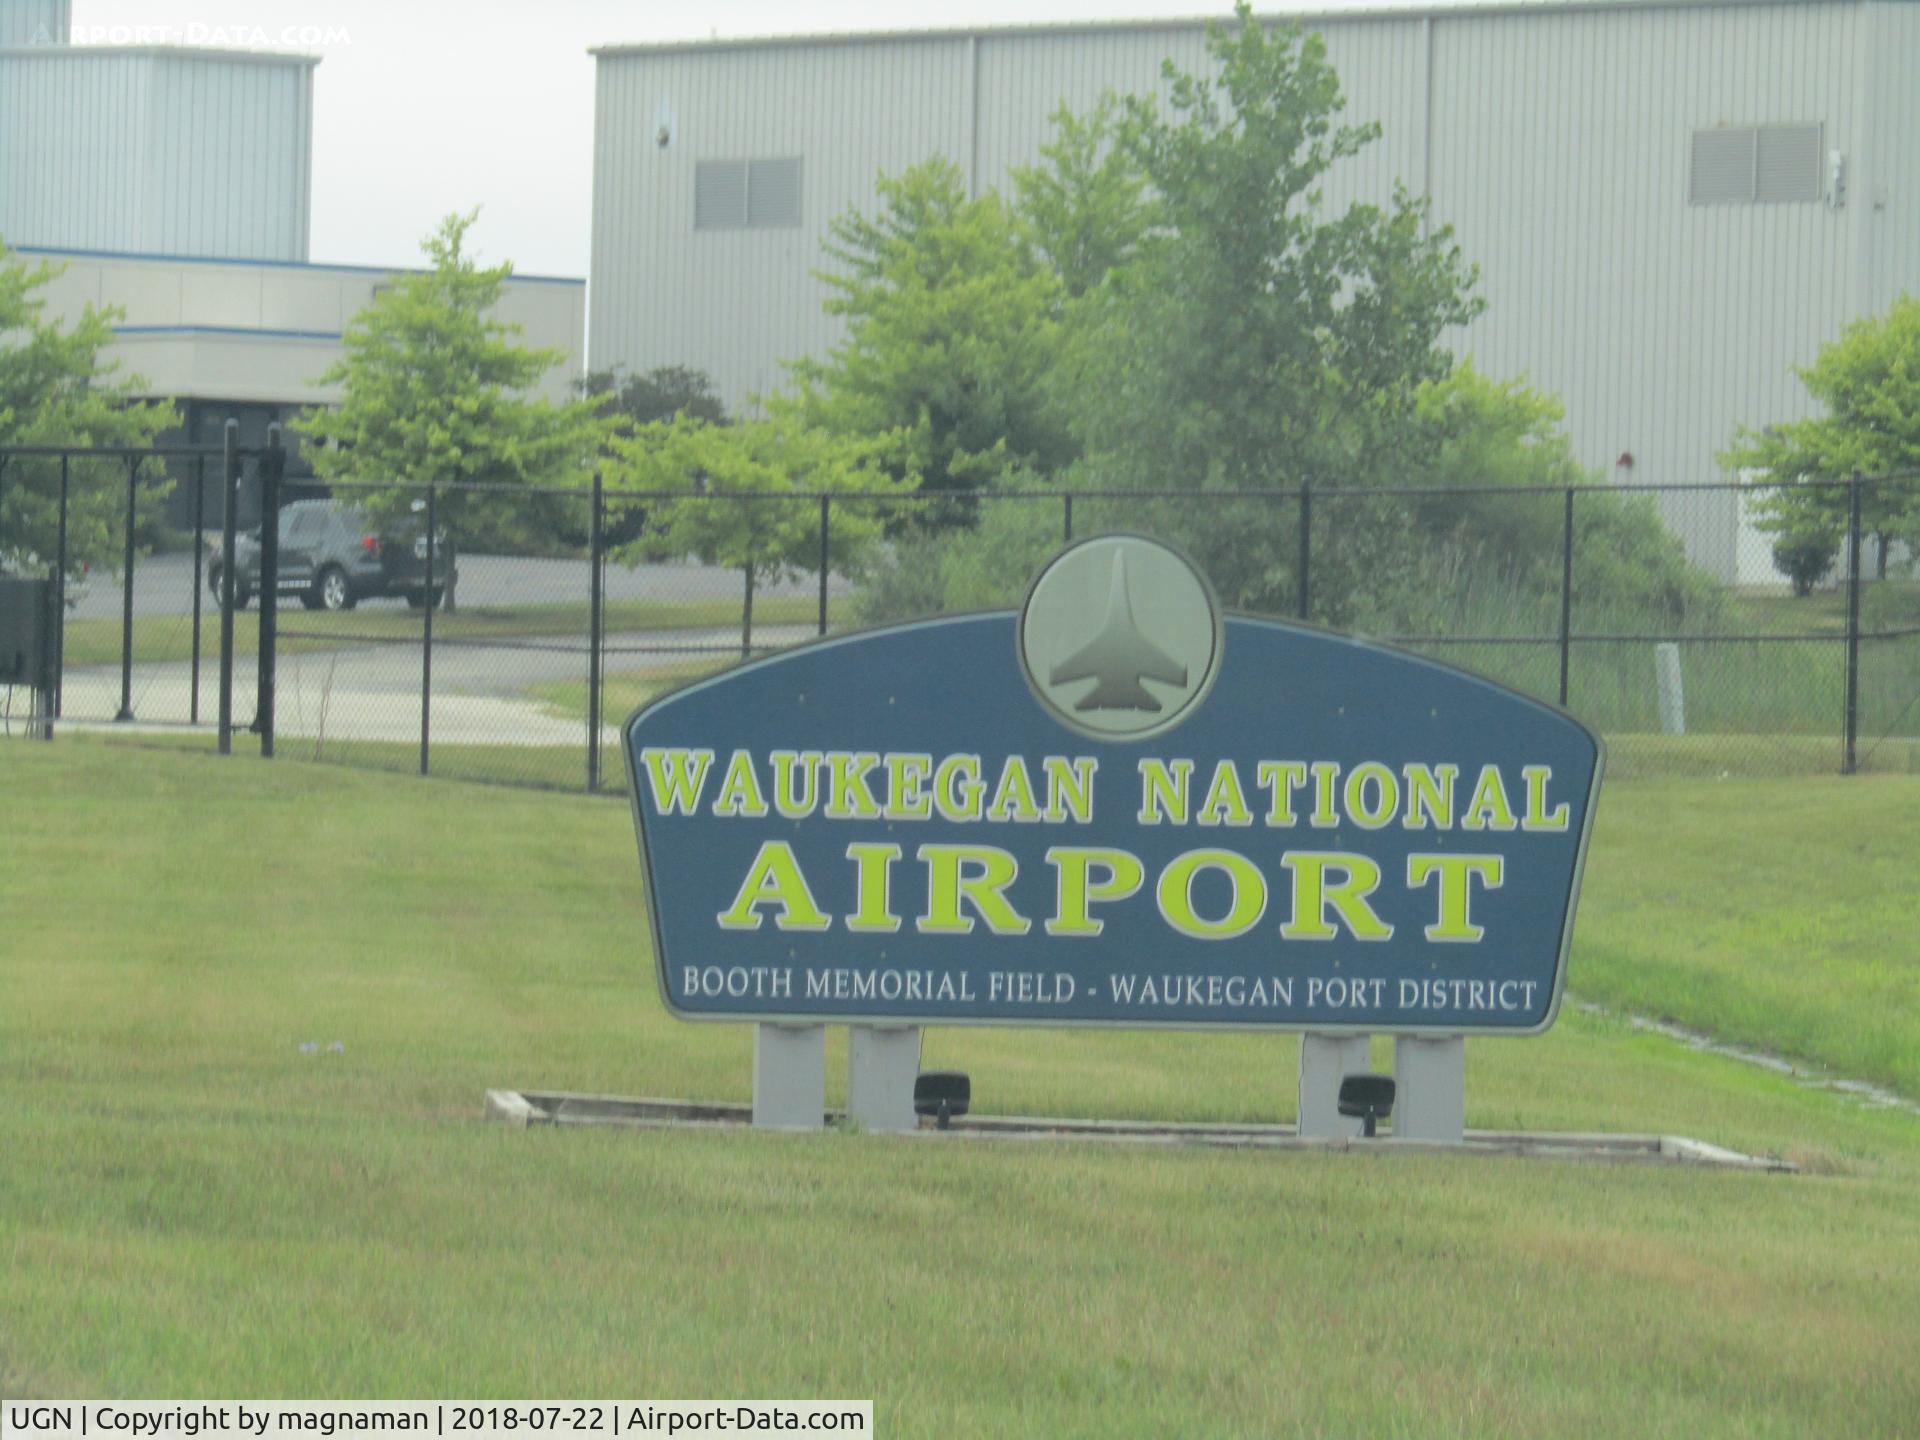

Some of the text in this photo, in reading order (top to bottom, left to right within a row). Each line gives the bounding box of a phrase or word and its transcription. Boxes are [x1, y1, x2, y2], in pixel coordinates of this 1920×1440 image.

[640, 748, 1570, 832] WAUKEGAN NATIONAL
[716, 839, 1505, 943] AIRPORT
[682, 965, 793, 999] BOOTH
[805, 967, 976, 1002] MEMORIAL
[988, 970, 1076, 1003] FIELD
[1110, 973, 1294, 1007] WAUKEGAN
[1306, 976, 1387, 1009] PORT
[1399, 978, 1538, 1012] DISTRICT
